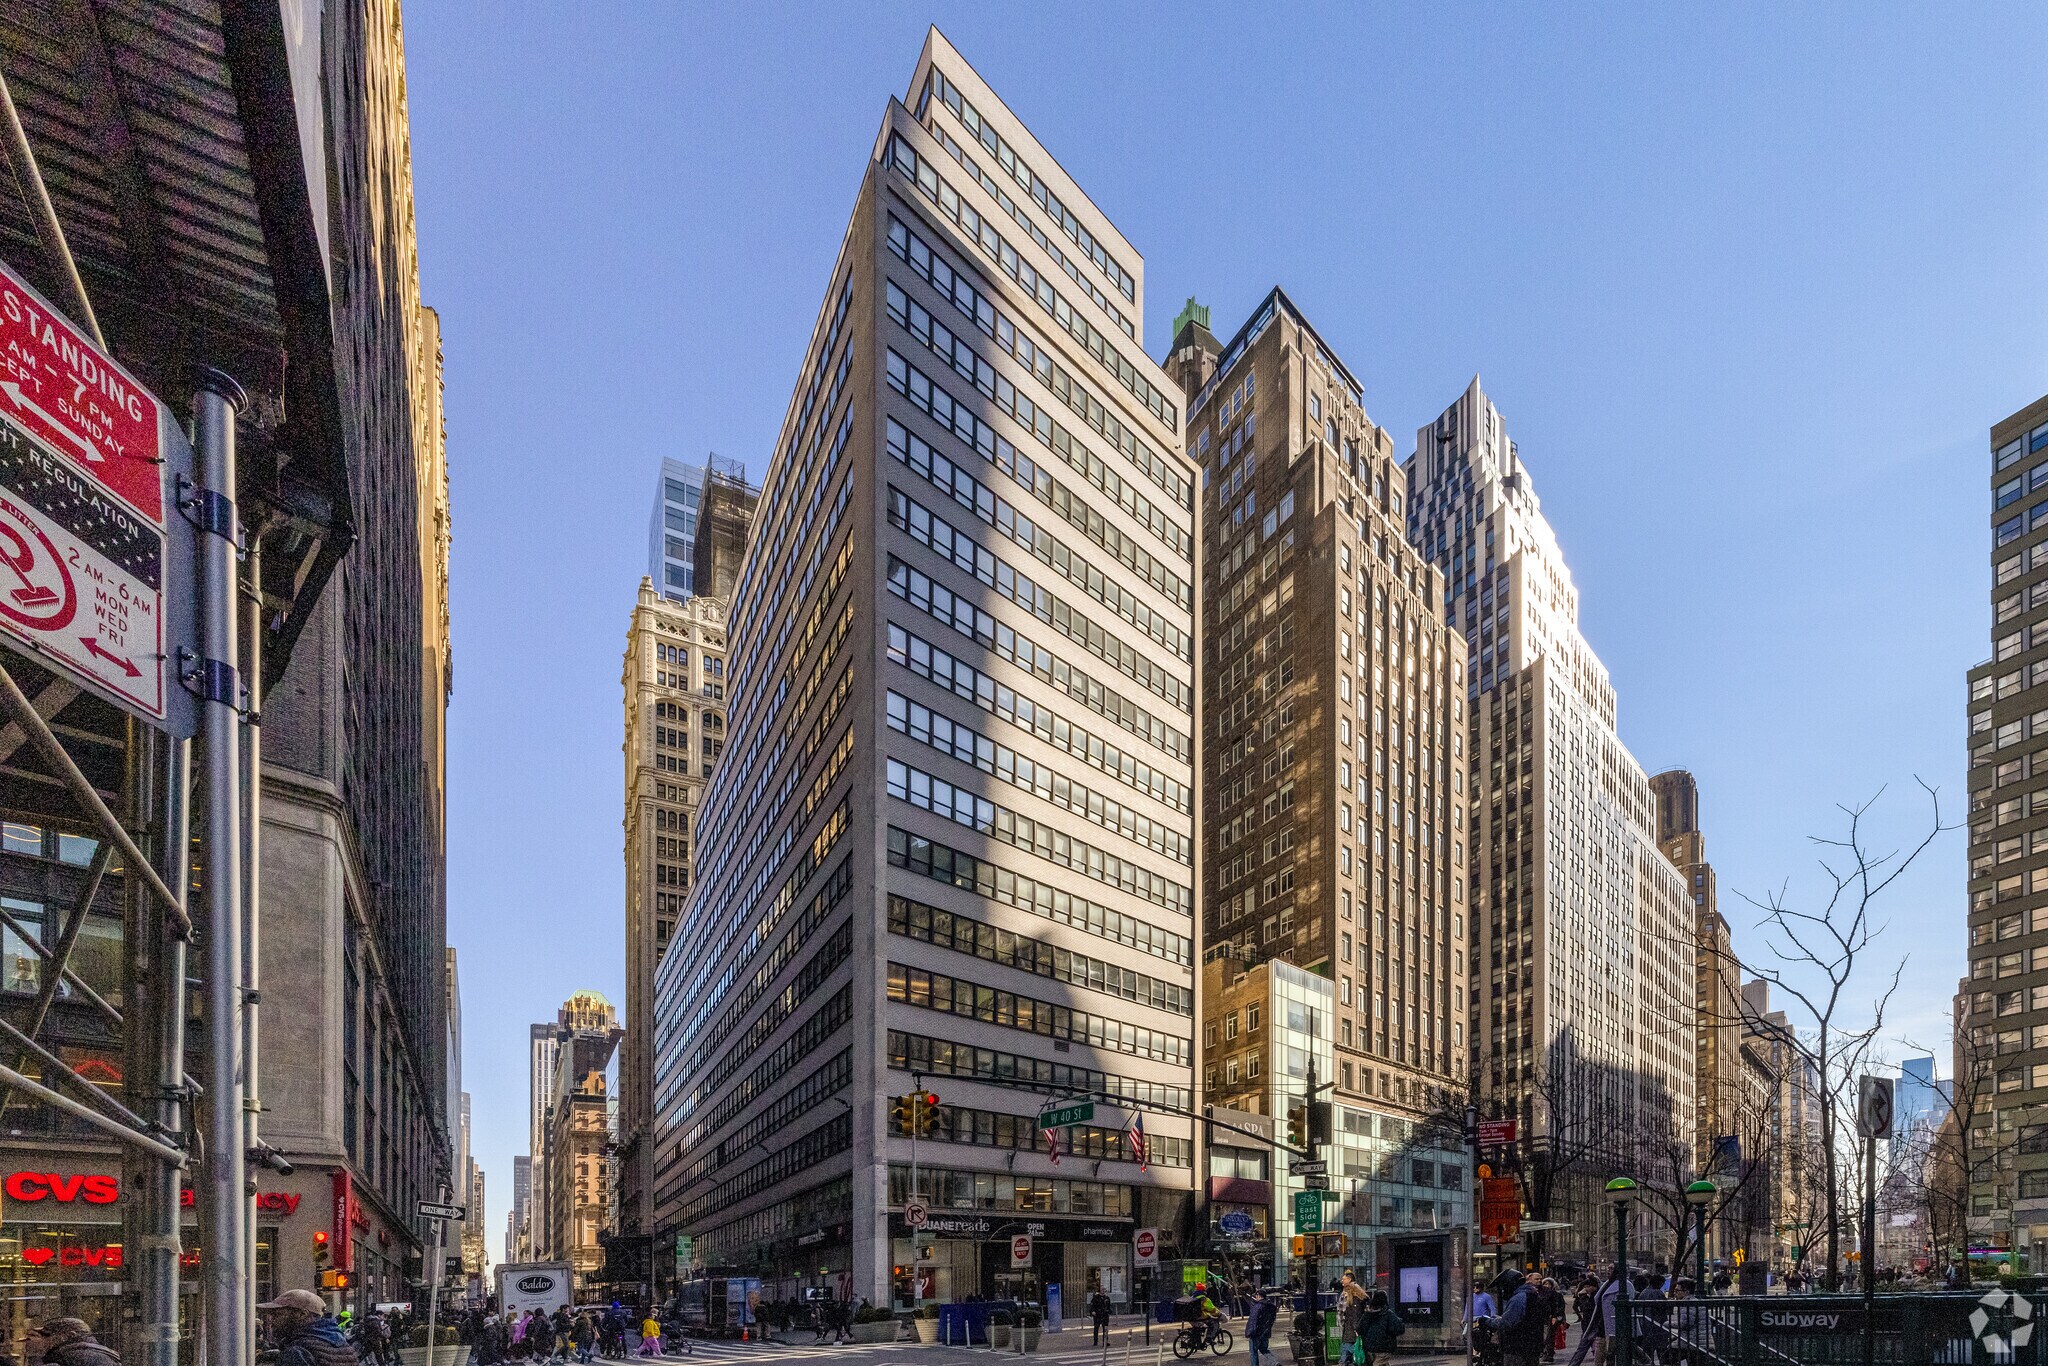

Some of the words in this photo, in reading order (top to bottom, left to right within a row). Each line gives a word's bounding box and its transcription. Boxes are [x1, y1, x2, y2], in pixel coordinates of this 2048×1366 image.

[4, 290, 142, 422] STANDING
[8, 340, 36, 369] AM
[67, 372, 86, 404] 7
[89, 401, 113, 430] PM
[58, 397, 124, 456] SUNDAY
[30, 448, 139, 538] REGULATION
[9, 505, 40, 536] LITTER
[68, 546, 80, 569] 2
[84, 563, 103, 584] AM
[118, 583, 130, 600] 6
[132, 595, 151, 616] AM
[94, 602, 128, 633] WED
[95, 586, 128, 618] MON
[98, 622, 124, 648] FRI
[1050, 1112, 1058, 1125] W
[1060, 1110, 1071, 1122] 40
[1073, 1107, 1082, 1120] St
[1244, 1122, 1265, 1138] SPA
[5, 1171, 119, 1204] CVS
[1083, 1227, 1114, 1236] pharmacy
[1299, 1213, 1317, 1221] Side
[61, 1247, 122, 1266] CVS
[522, 1277, 552, 1290] Baldor
[1760, 1311, 1840, 1329] Subway
